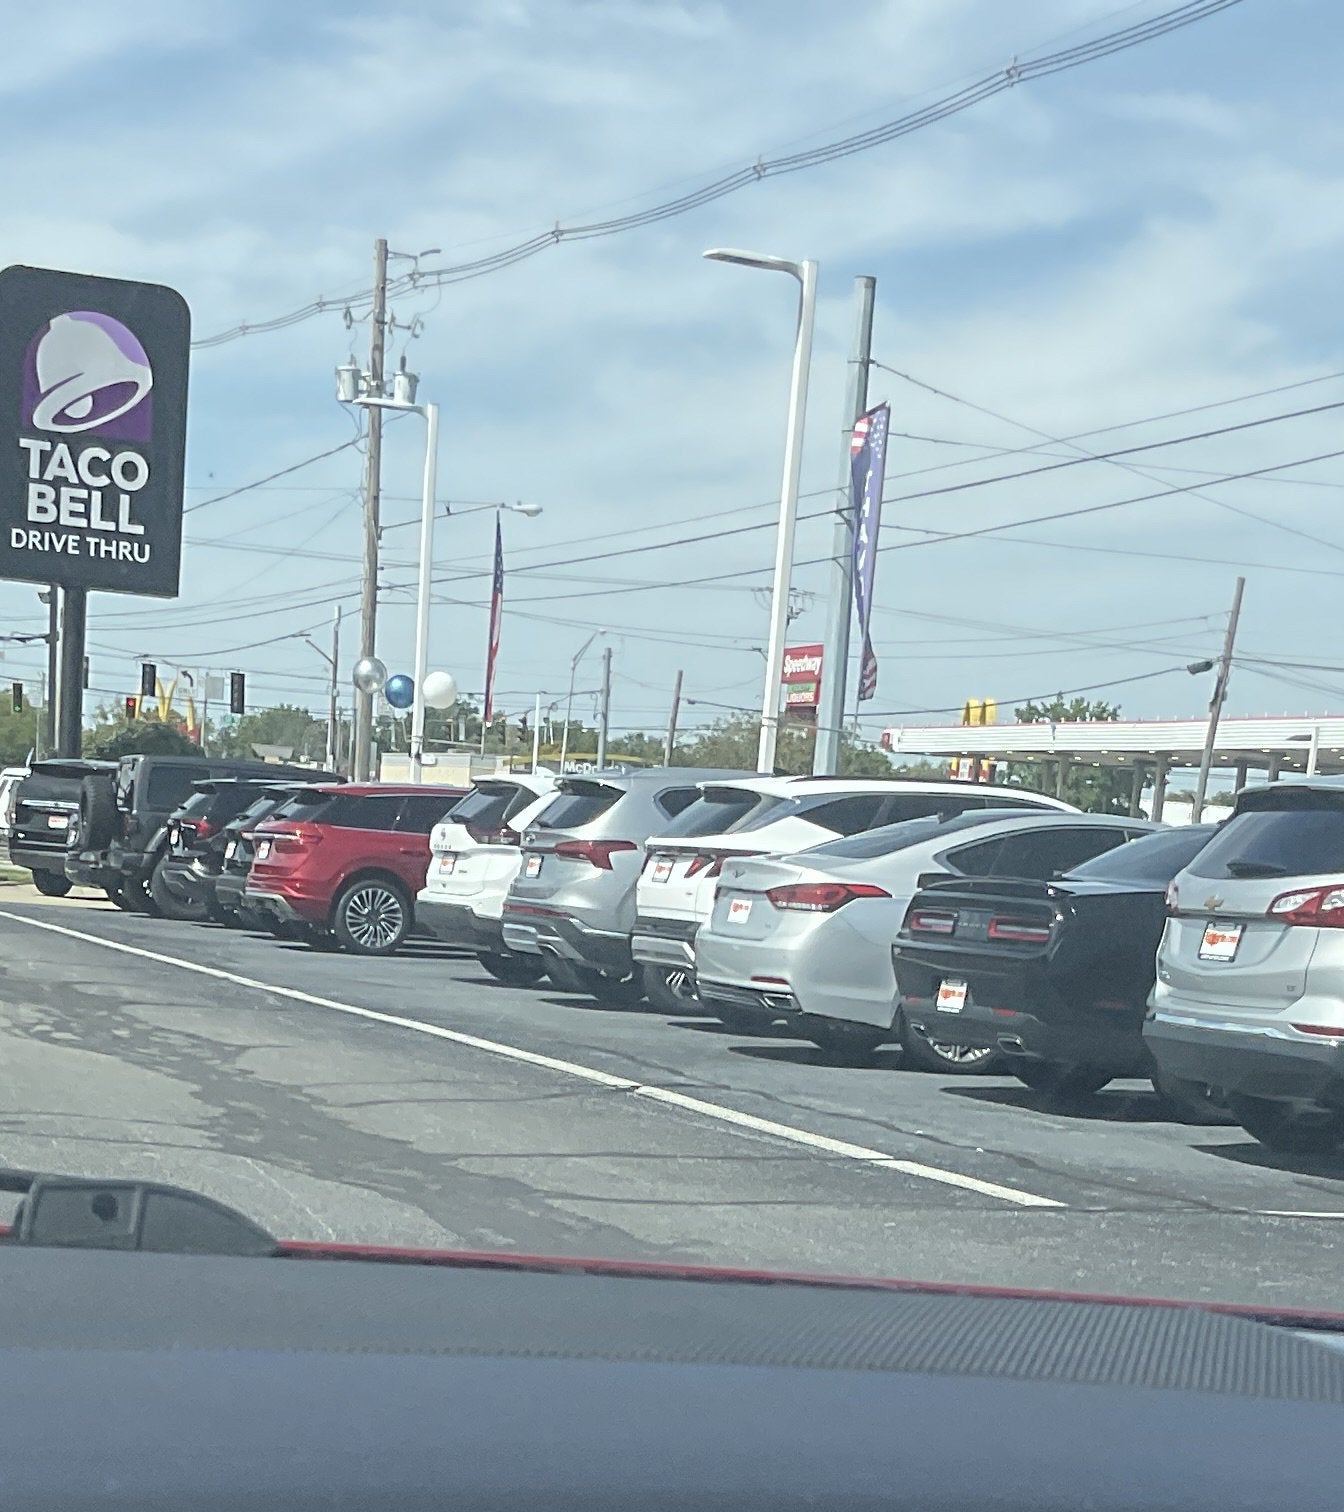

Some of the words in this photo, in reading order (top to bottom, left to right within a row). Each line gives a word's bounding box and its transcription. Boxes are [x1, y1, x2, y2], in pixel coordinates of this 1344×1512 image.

[19, 437, 149, 491] TACO
[27, 482, 145, 535] BELL
[10, 528, 80, 555] DRIVE
[86, 537, 150, 563] THRU
[783, 654, 822, 678] Speedway
